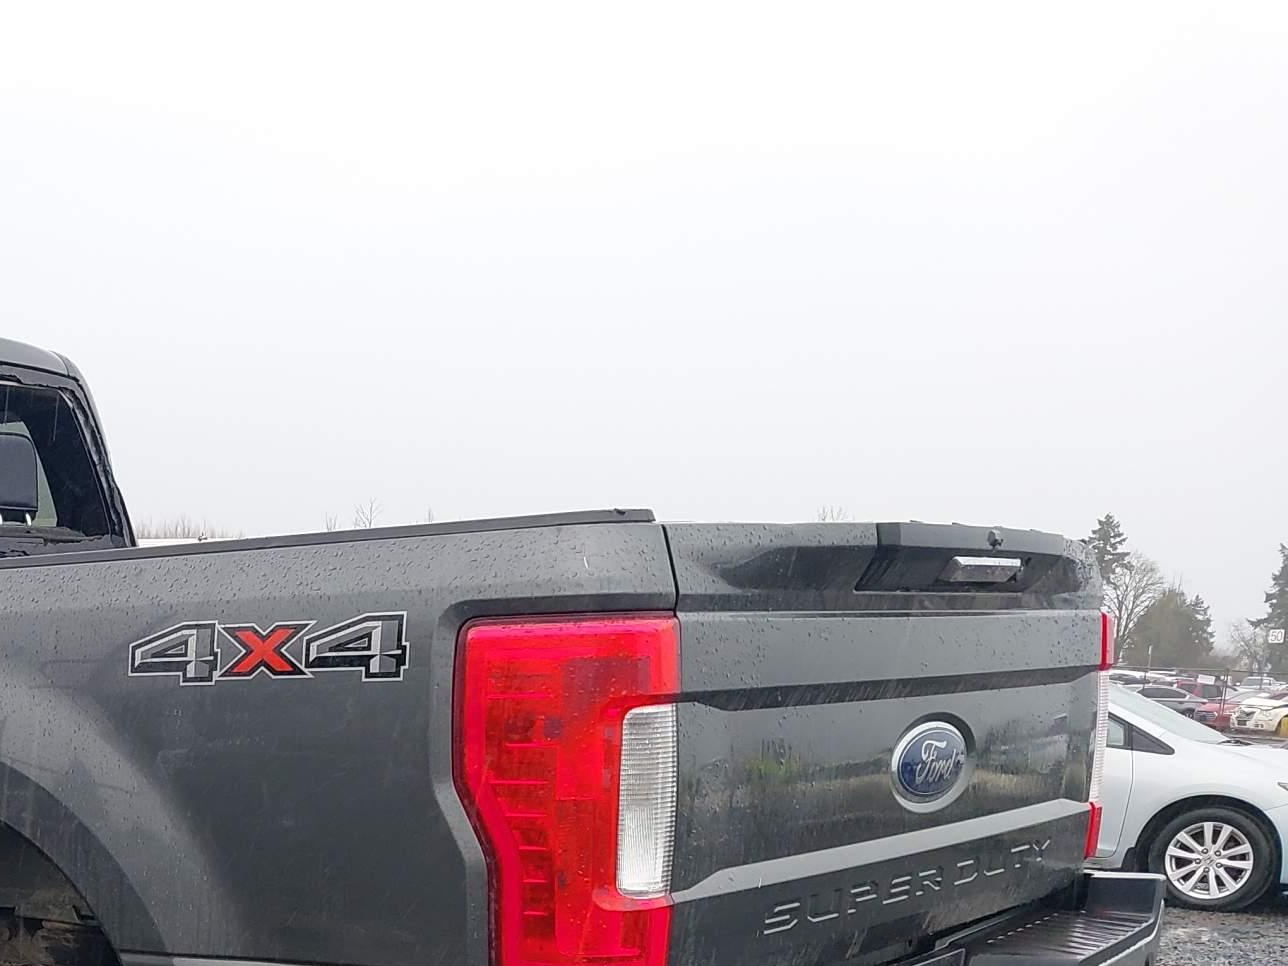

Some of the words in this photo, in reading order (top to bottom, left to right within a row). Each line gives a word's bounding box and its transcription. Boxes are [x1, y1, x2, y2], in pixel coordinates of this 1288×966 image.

[128, 611, 410, 686] 4X4
[1271, 630, 1283, 642] 50
[915, 740, 957, 784] Ford
[762, 869, 942, 934] SUPER
[954, 839, 1051, 886] DUTY
